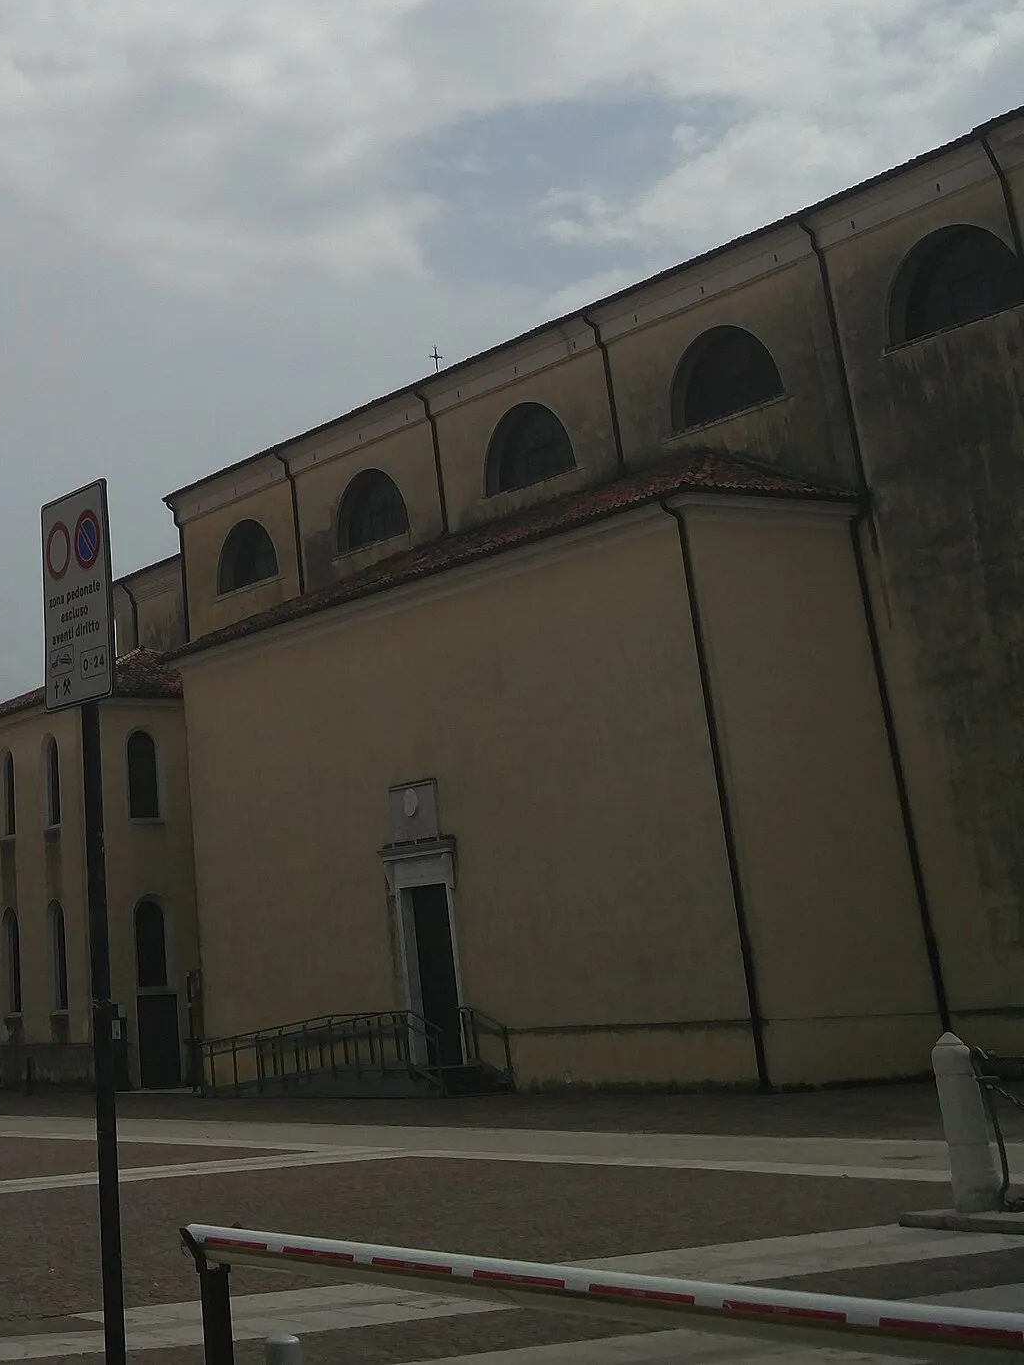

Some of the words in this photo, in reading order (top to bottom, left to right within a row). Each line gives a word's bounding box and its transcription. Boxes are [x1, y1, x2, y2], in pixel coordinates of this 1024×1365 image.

[49, 594, 65, 608] zona
[66, 580, 101, 604] pedonale
[61, 605, 89, 623] escluso
[52, 627, 74, 645] aventi
[75, 620, 100, 637] diritto
